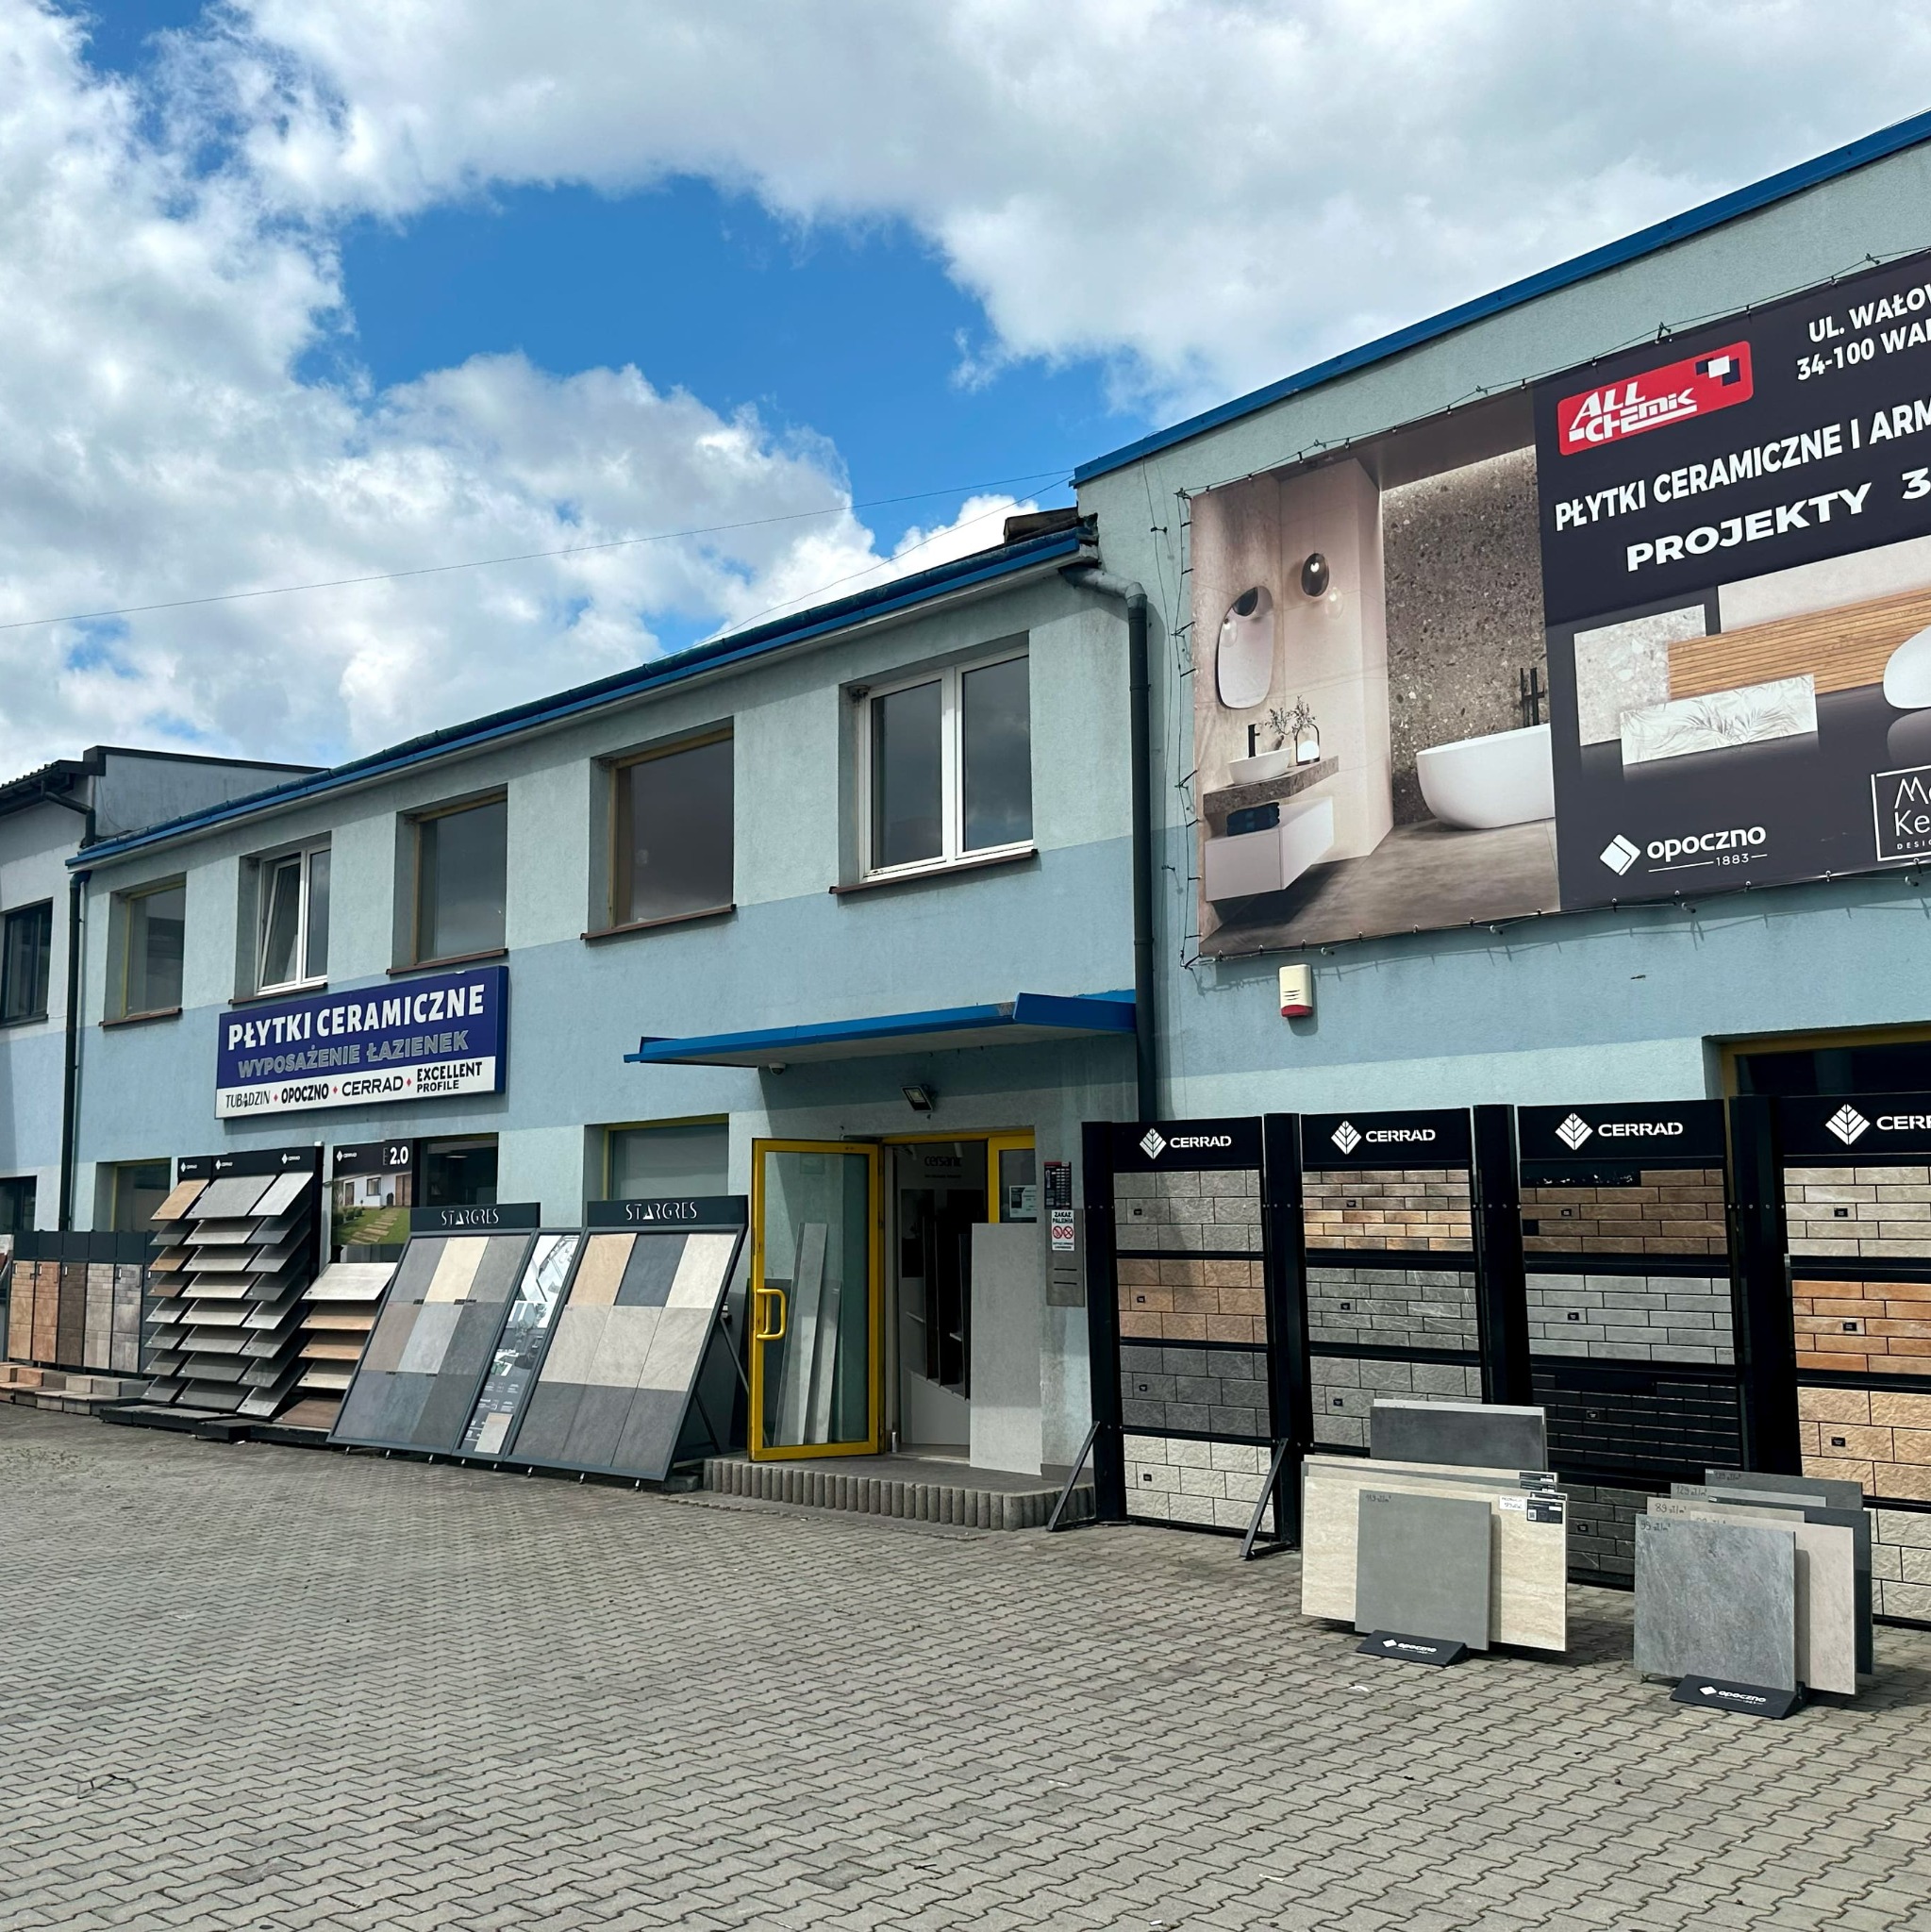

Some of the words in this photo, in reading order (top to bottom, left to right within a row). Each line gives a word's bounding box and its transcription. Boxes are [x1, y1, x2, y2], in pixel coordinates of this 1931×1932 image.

[1808, 316, 1845, 342] UL.
[1796, 339, 1874, 380] 34-100
[1570, 381, 1646, 430] ALL
[1555, 479, 1645, 532] PŁYTKI
[1653, 424, 1843, 504] CERAMICZNE
[1850, 418, 1860, 449] I
[1626, 482, 1872, 573] PROJEKTY
[1894, 775, 1931, 808] M
[1647, 825, 1766, 862] opoczno
[1715, 852, 1749, 867] 1883
[228, 1011, 310, 1051] PŁYTKI
[317, 984, 485, 1037] CERAMICZNE
[238, 1044, 360, 1078] WYPOSAŻENIE
[366, 1030, 469, 1062] ŁAZIENEK
[281, 1083, 329, 1104] OPOCZNO
[341, 1076, 404, 1096] CERRAD
[416, 1061, 483, 1082] EXCELLENT
[416, 1079, 460, 1092] PROFILE
[1365, 1128, 1436, 1144] CERRAD
[1597, 1121, 1683, 1137] CERRAD
[390, 1145, 409, 1165] 2.0
[1170, 1135, 1232, 1150] CERRAD
[441, 1208, 499, 1227] STARGRES
[625, 1201, 698, 1221] STARGRES
[1718, 1690, 1767, 1702] opoczno
